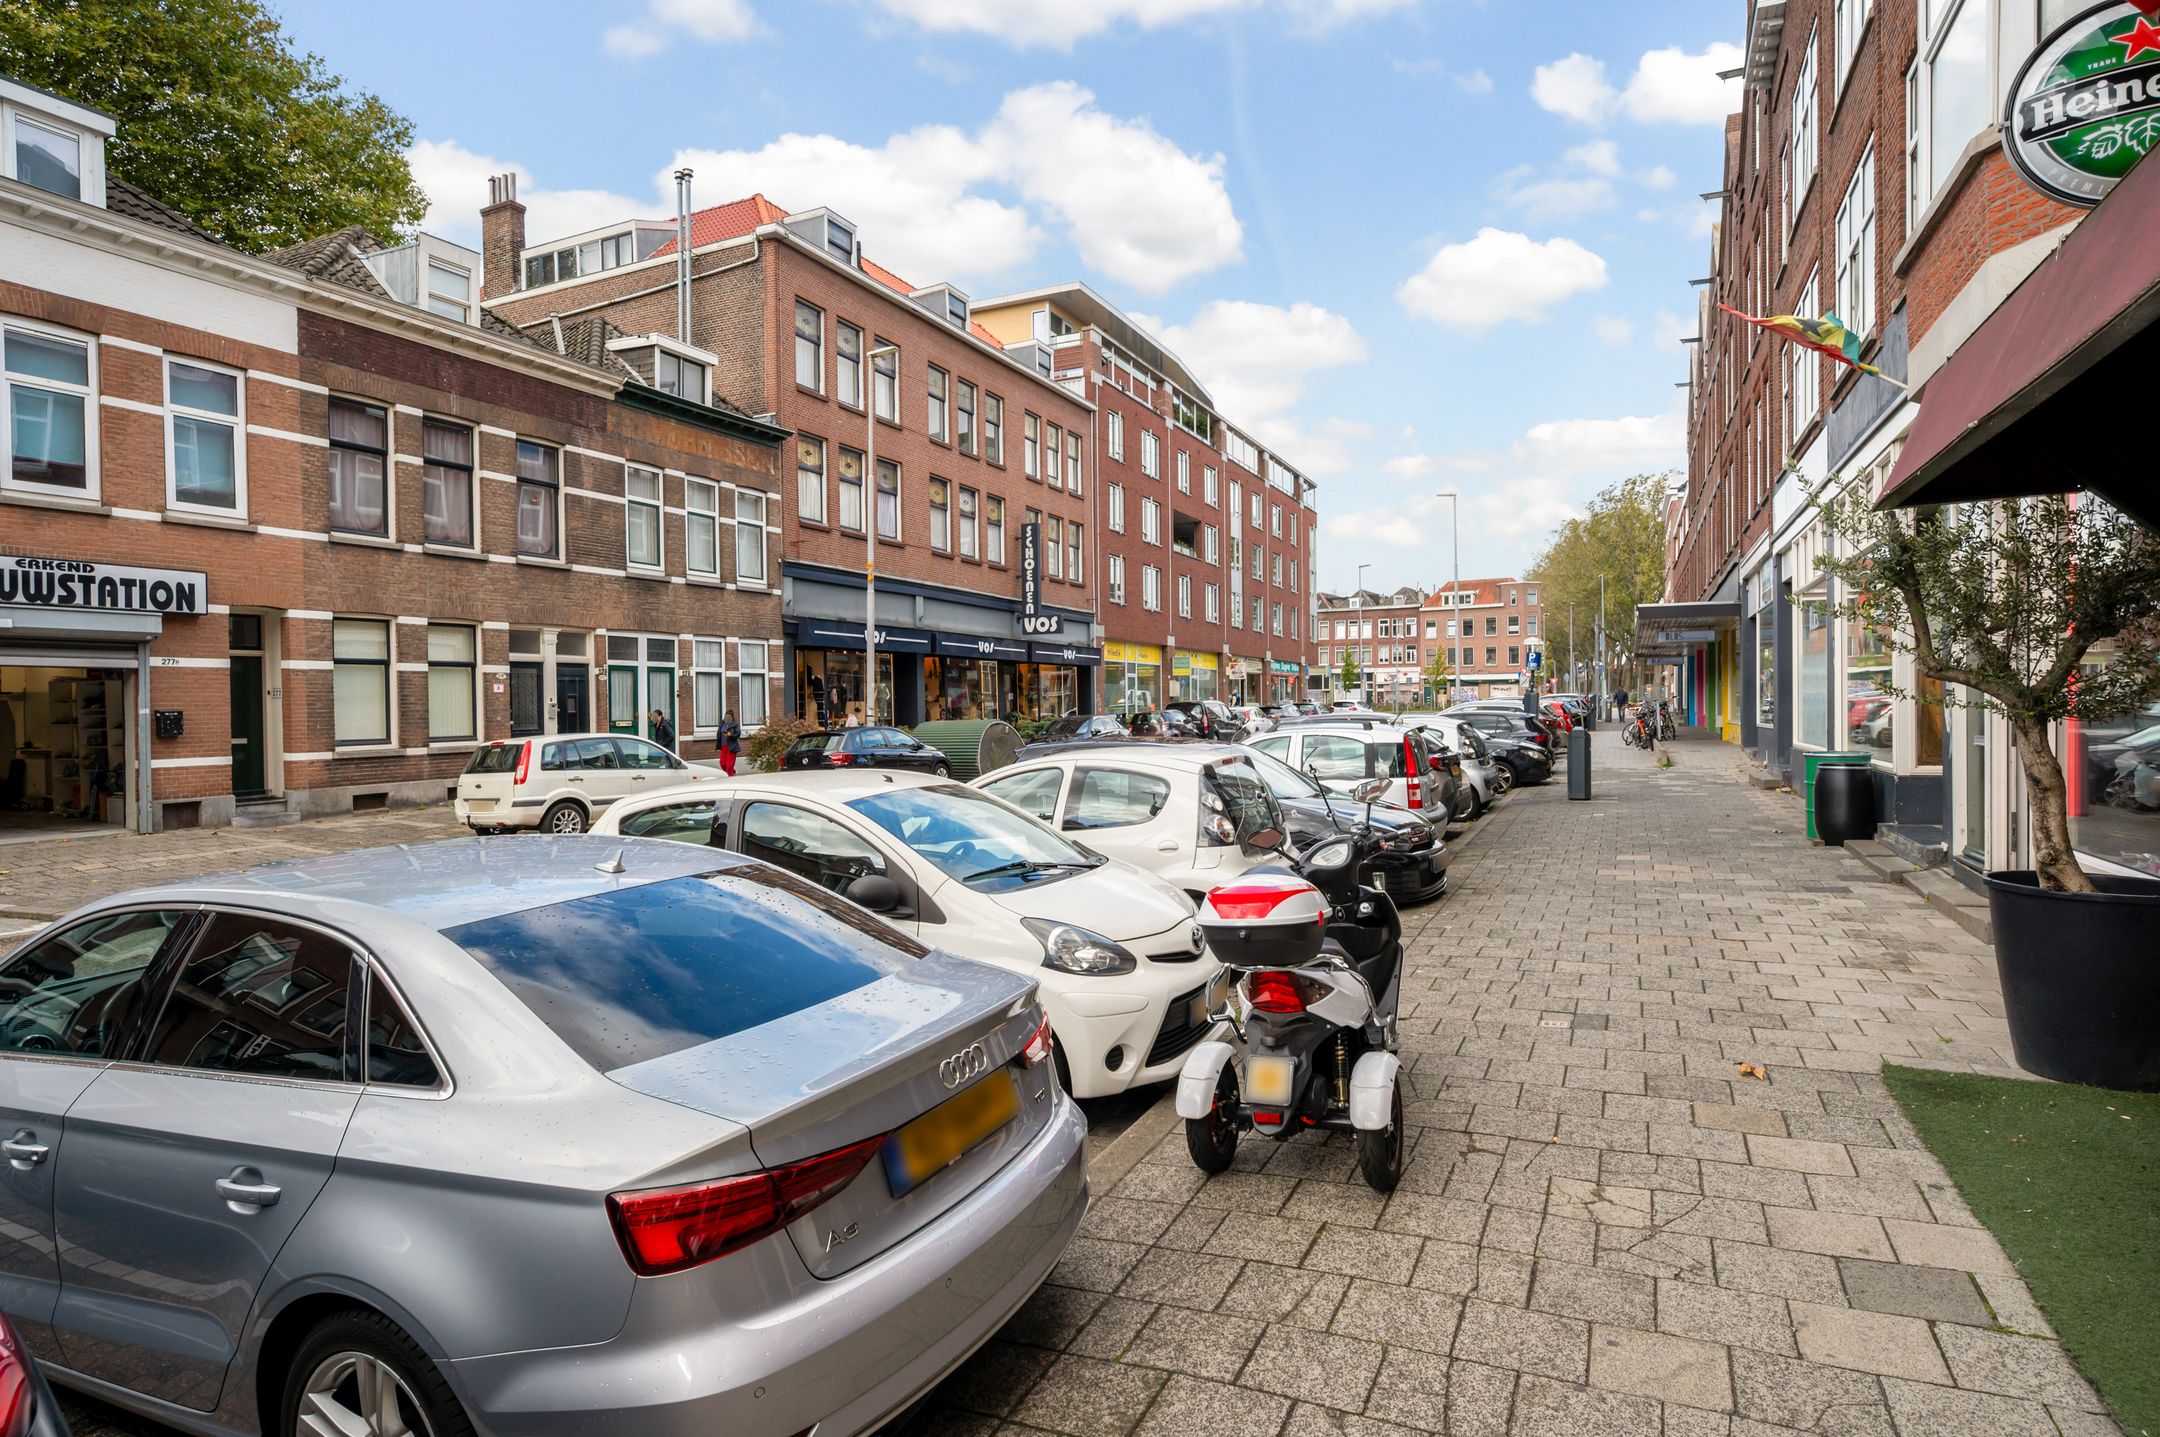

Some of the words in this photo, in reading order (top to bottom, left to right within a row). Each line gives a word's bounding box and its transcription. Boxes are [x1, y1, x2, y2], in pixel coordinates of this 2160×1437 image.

[2087, 57, 2117, 70] TRADE
[2047, 168, 2113, 194] PREMI
[15, 558, 95, 574] ERKEND
[1024, 525, 1035, 615] SCHOENEN
[1024, 616, 1058, 633] VOS
[978, 641, 994, 653] VOS
[1063, 649, 1076, 660] VOS
[825, 1222, 859, 1253] A3
